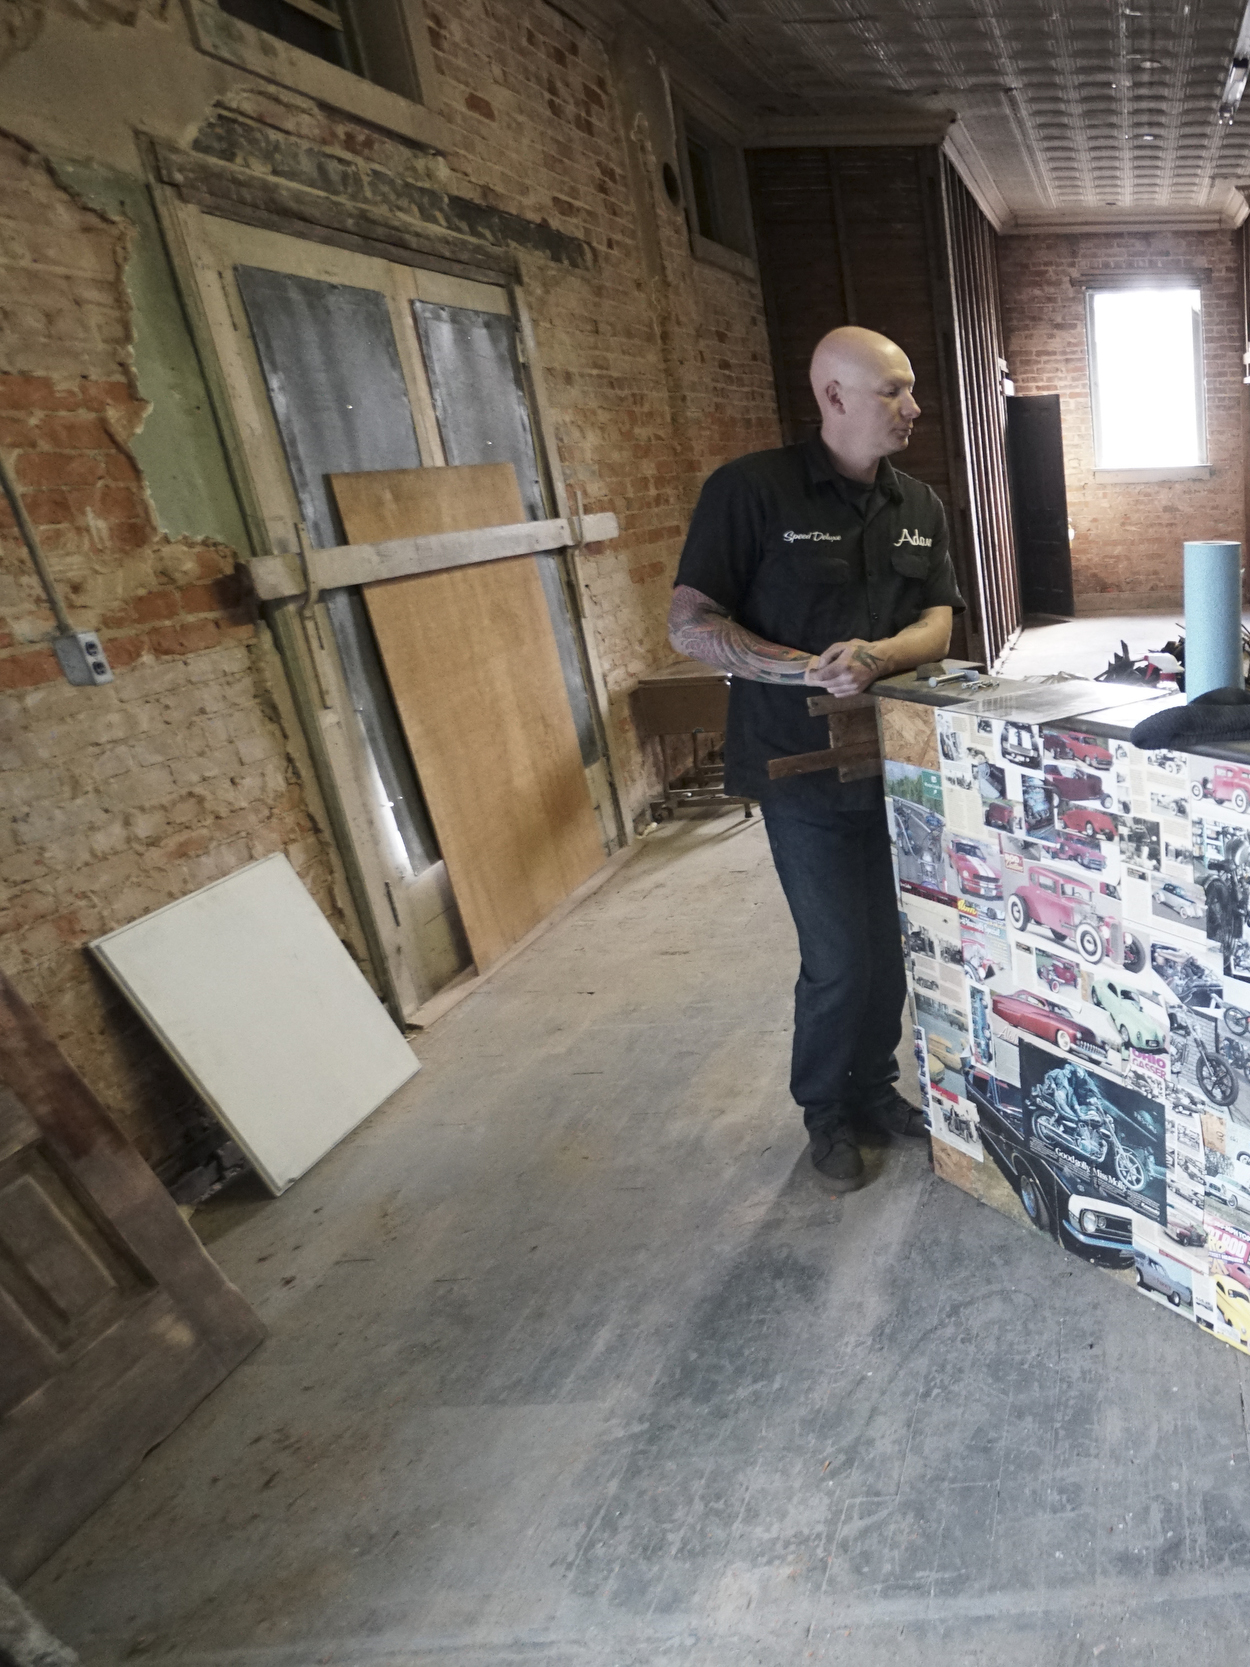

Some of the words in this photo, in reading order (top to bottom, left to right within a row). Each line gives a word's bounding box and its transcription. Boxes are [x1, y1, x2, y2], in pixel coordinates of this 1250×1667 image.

[783, 530, 813, 543] Speed
[812, 531, 842, 543] Deluxe
[1131, 1058, 1167, 1079] GASSER
[1132, 1049, 1167, 1070] OHIO
[1055, 1147, 1075, 1165] Good
[1221, 1232, 1249, 1259] ROD
